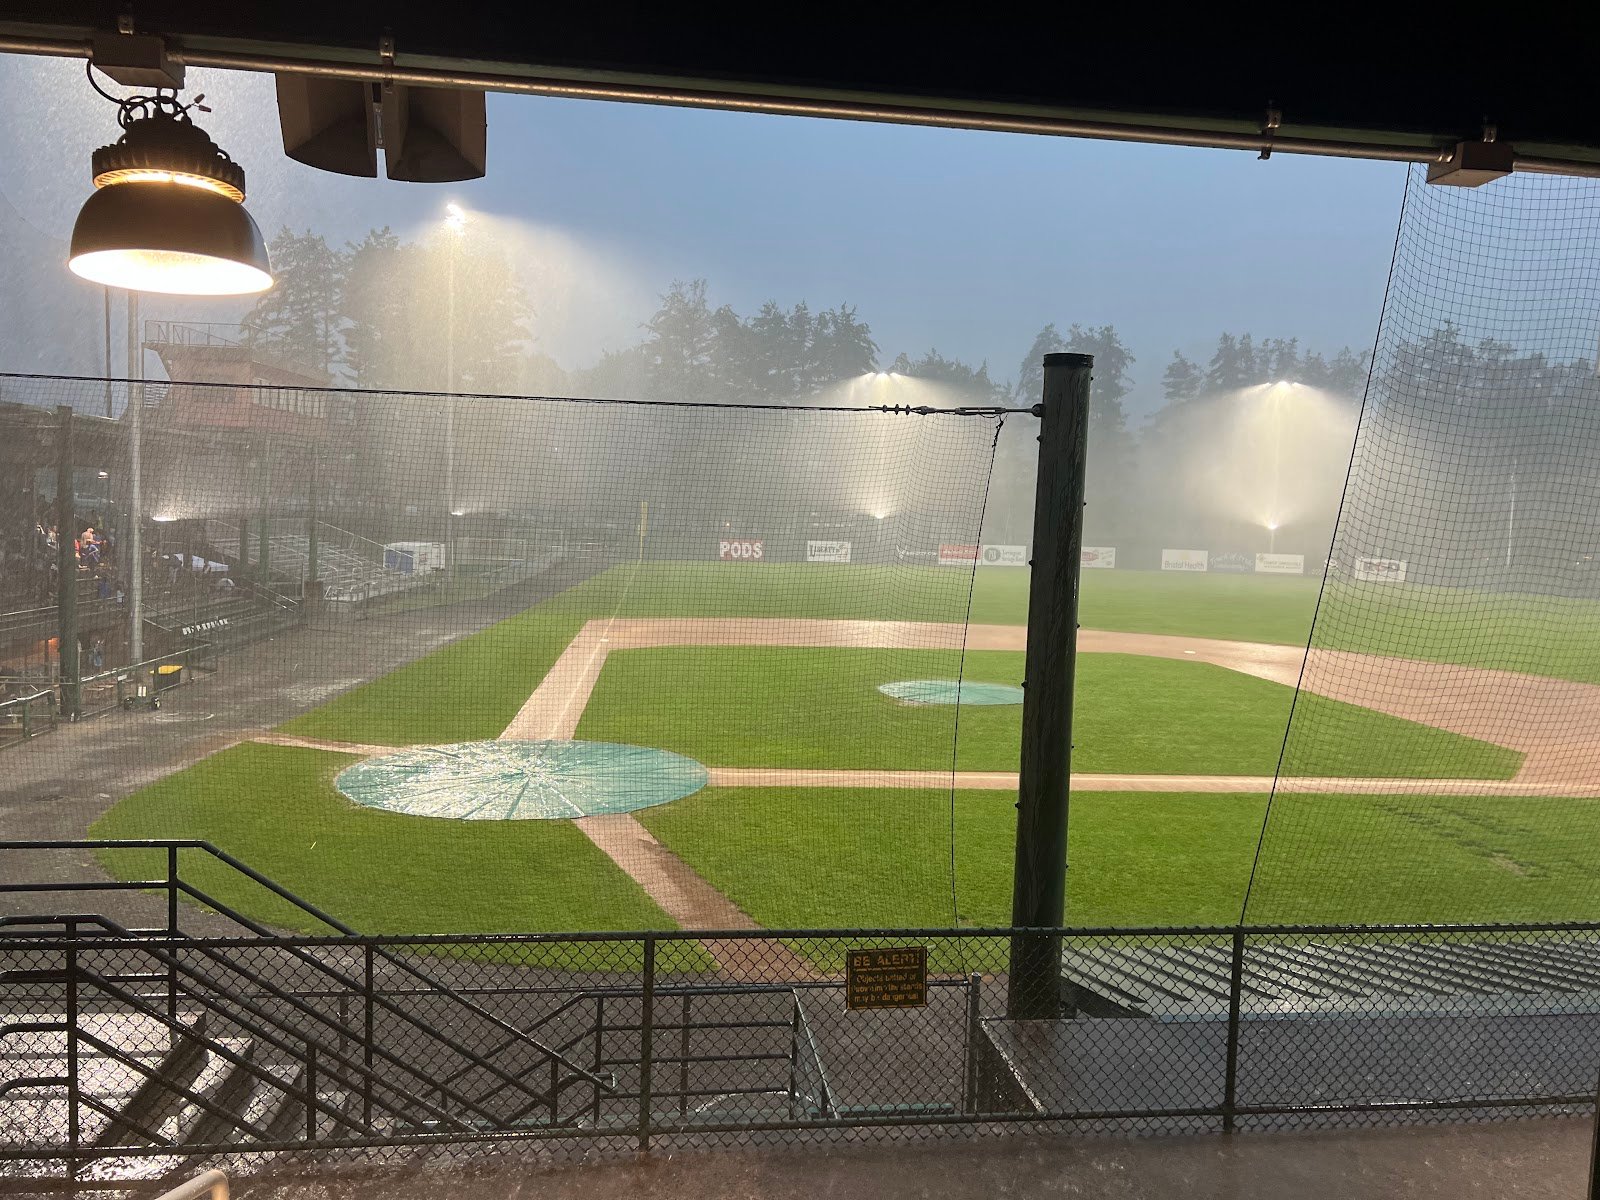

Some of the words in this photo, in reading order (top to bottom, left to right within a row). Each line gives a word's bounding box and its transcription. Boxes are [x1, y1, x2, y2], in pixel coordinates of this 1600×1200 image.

[720, 541, 763, 558] PODS
[1164, 561, 1184, 569] Bristol
[1184, 561, 1204, 570] Health
[853, 955, 870, 967] BE
[877, 953, 920, 966] ALERT!
[856, 974, 883, 984] Objects
